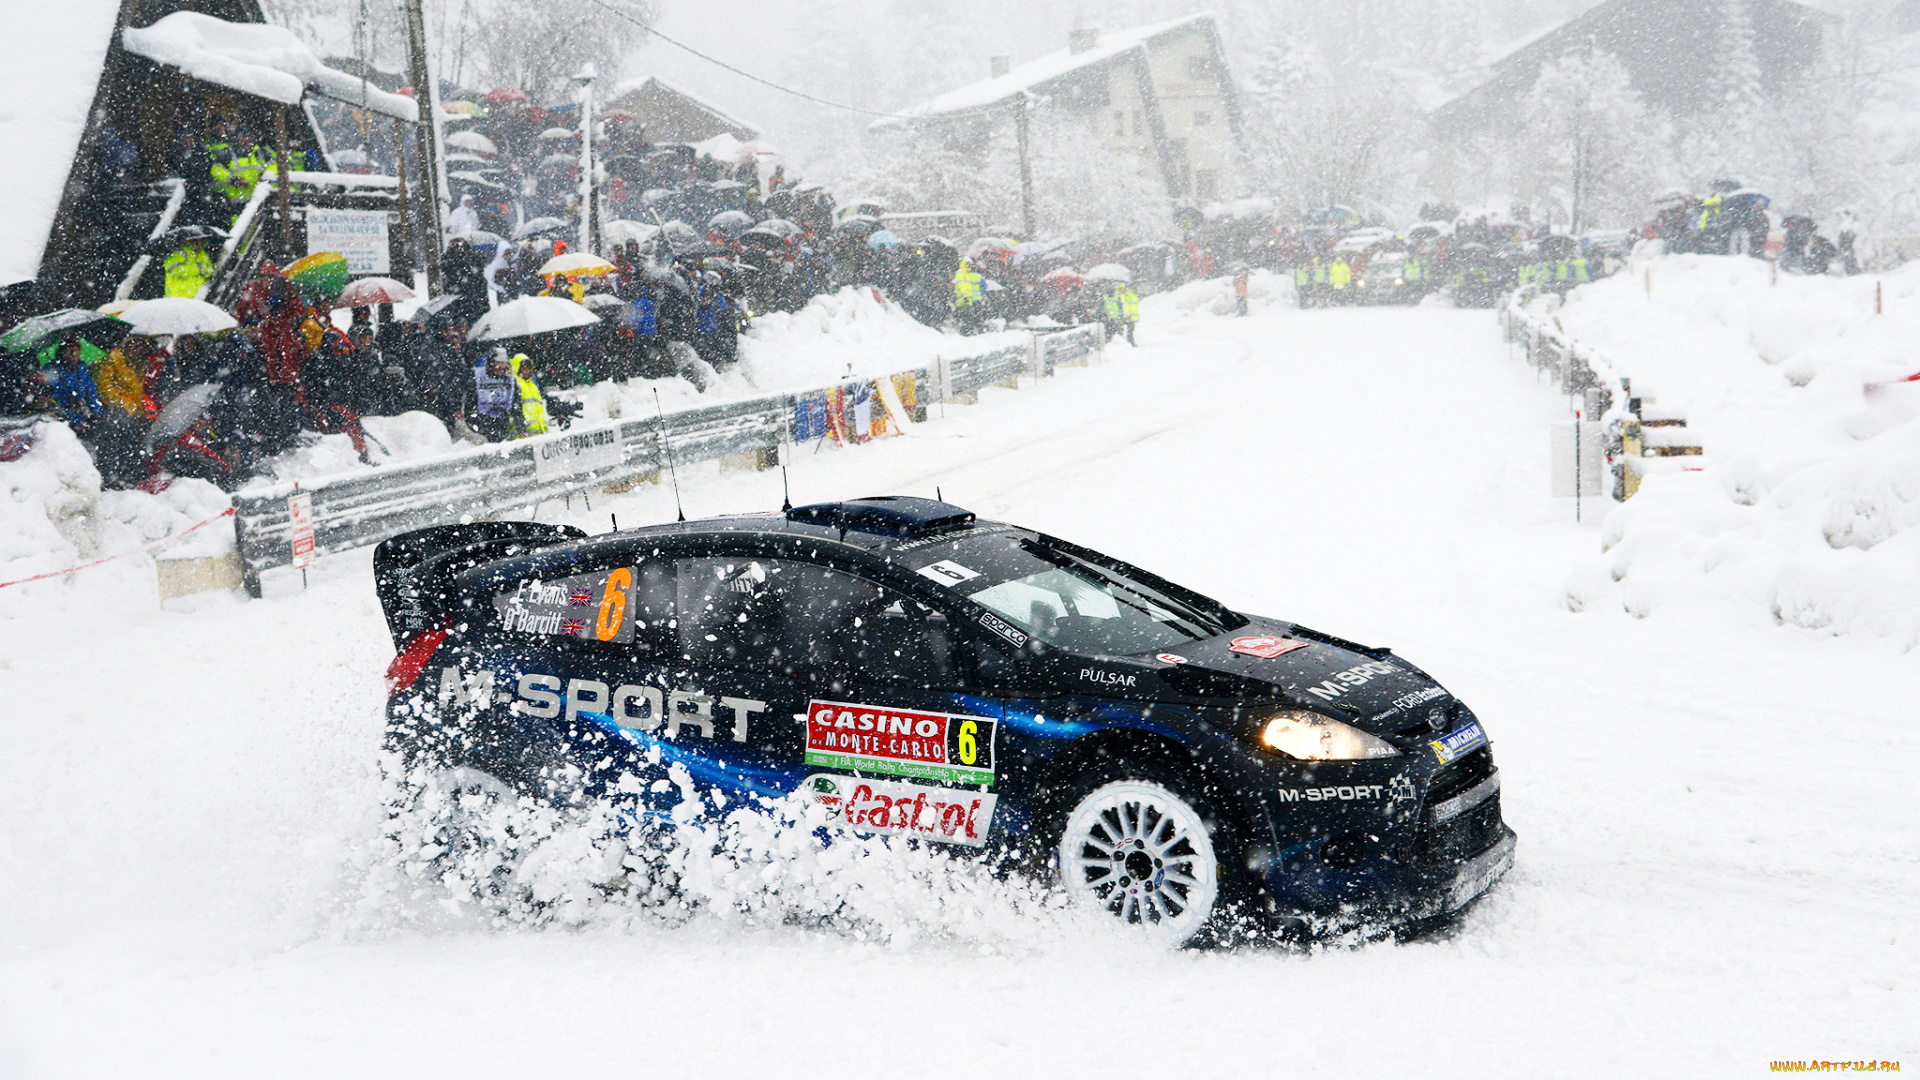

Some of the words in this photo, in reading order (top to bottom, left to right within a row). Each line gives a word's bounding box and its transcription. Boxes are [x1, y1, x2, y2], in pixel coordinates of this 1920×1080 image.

[930, 565, 966, 580] 6
[595, 567, 633, 642] 6
[517, 609, 562, 635] Barritt
[983, 614, 1026, 643] sparco
[1079, 669, 1137, 688] PULSAR
[439, 667, 766, 743] M-SPORT
[815, 709, 939, 738] CASINO
[958, 720, 978, 765] 6
[1367, 747, 1396, 757] PIAA
[855, 758, 875, 769] World
[878, 760, 896, 774] Rally
[898, 763, 950, 779] Championship
[1279, 785, 1384, 803] M-SPORT
